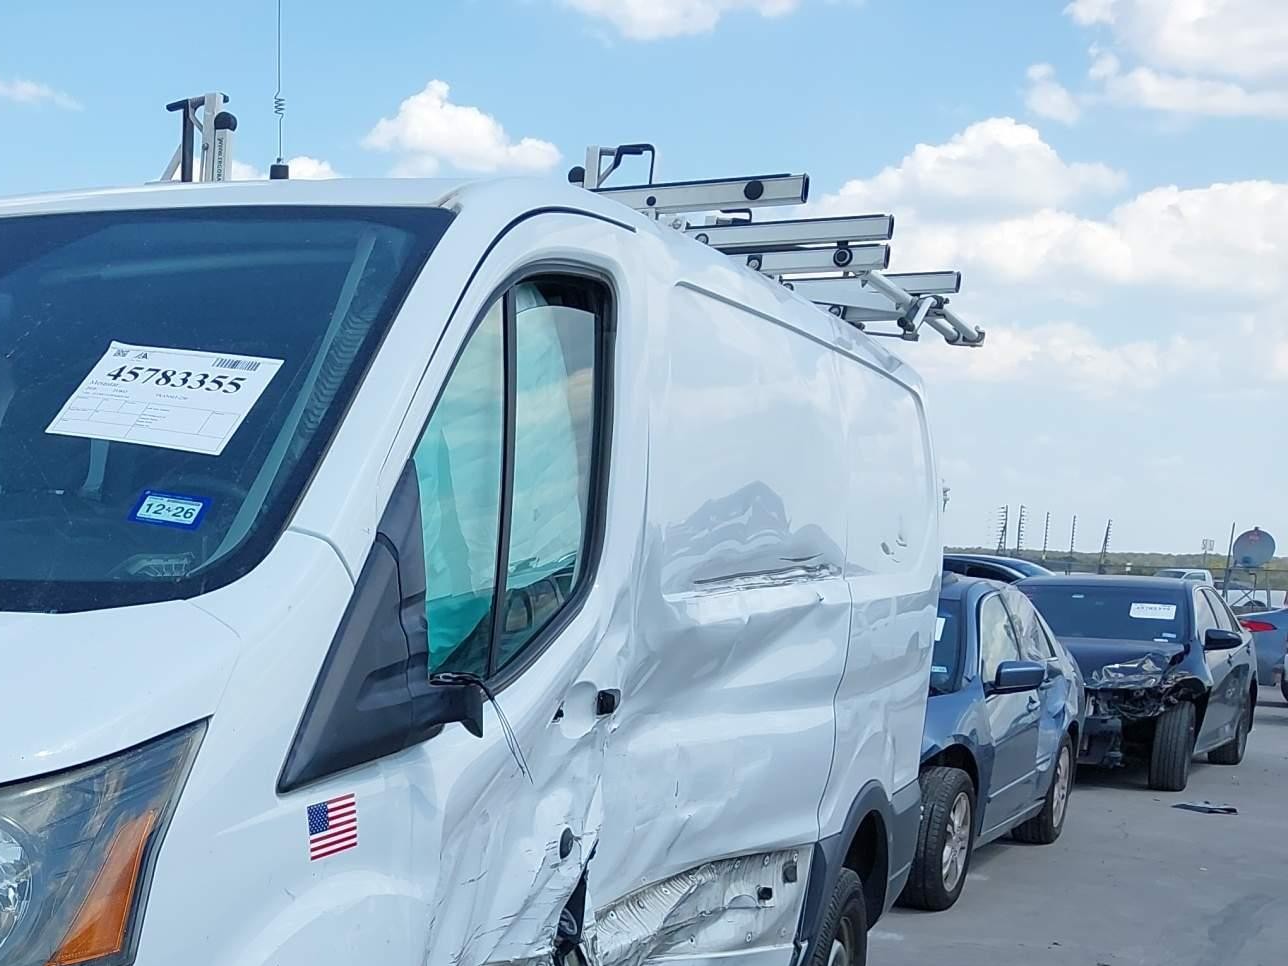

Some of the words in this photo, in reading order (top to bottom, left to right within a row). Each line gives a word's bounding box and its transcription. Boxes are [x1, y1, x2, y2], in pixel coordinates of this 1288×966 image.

[106, 364, 247, 395] 45783355
[145, 502, 166, 516] 12
[172, 506, 196, 519] 26
